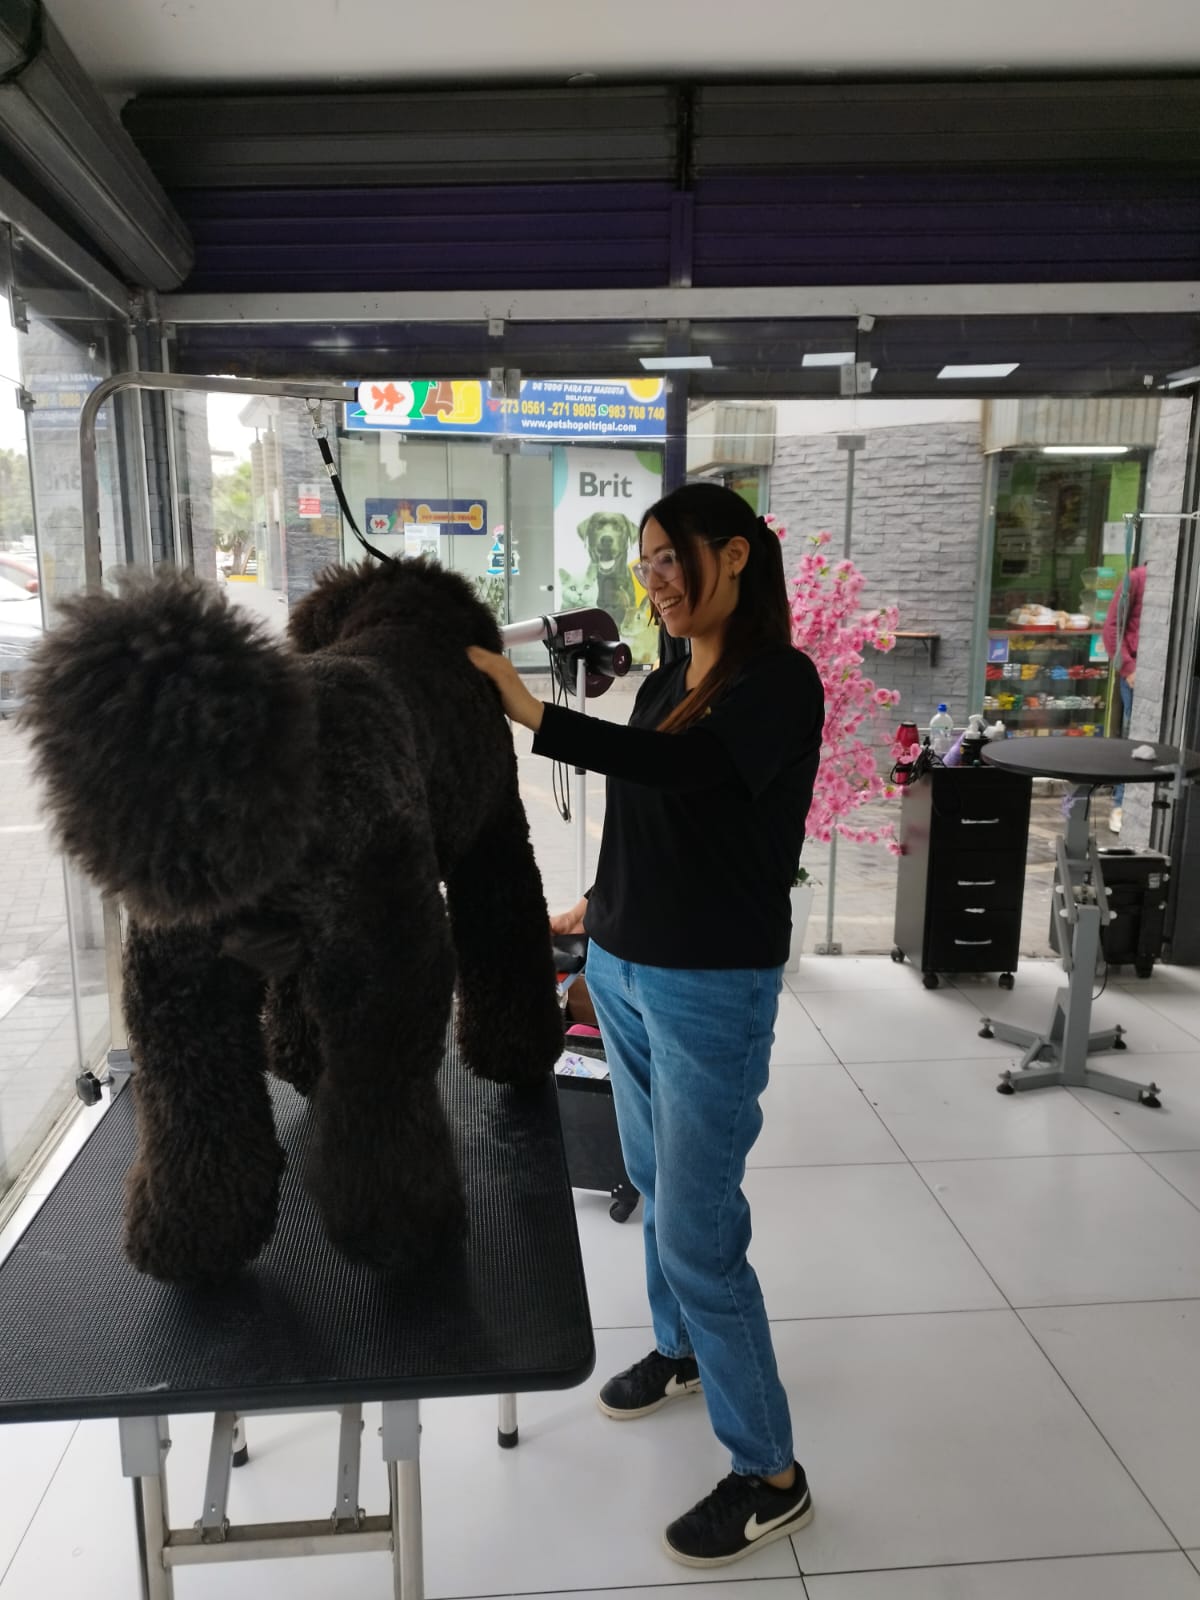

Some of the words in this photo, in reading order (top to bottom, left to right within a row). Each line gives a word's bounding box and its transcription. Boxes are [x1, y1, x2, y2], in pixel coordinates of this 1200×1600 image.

[543, 382, 563, 392] TODO
[563, 383, 582, 393] PARA
[583, 384, 593, 393] SU
[565, 394, 597, 402] DELIVERY
[500, 400, 519, 414] 273
[521, 401, 545, 415] 0561
[572, 403, 597, 417] 9805
[608, 405, 626, 419] 983
[648, 407, 665, 421] 740
[521, 419, 637, 433] www.petshopeltrigal.com
[579, 471, 632, 498] Brit
